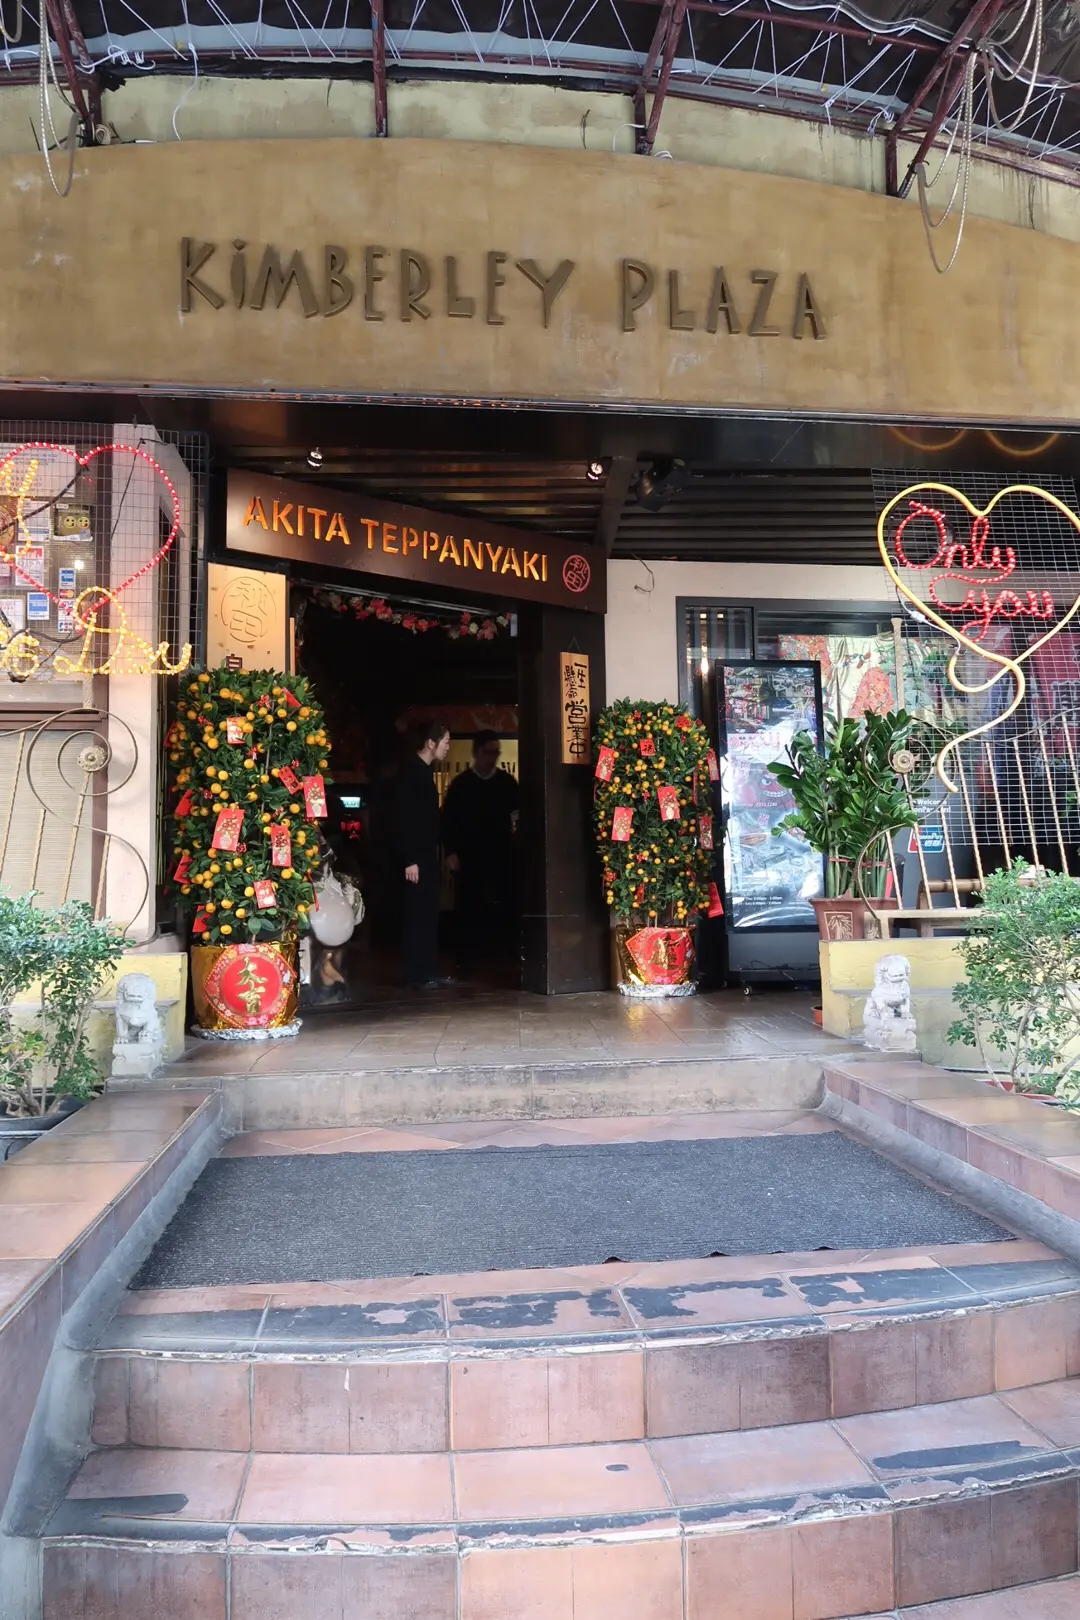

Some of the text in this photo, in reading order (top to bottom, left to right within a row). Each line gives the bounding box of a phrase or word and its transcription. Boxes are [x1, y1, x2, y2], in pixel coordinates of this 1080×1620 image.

[621, 257, 827, 340] PLAZA
[243, 495, 549, 583] AKITA TEPPANYAKI
